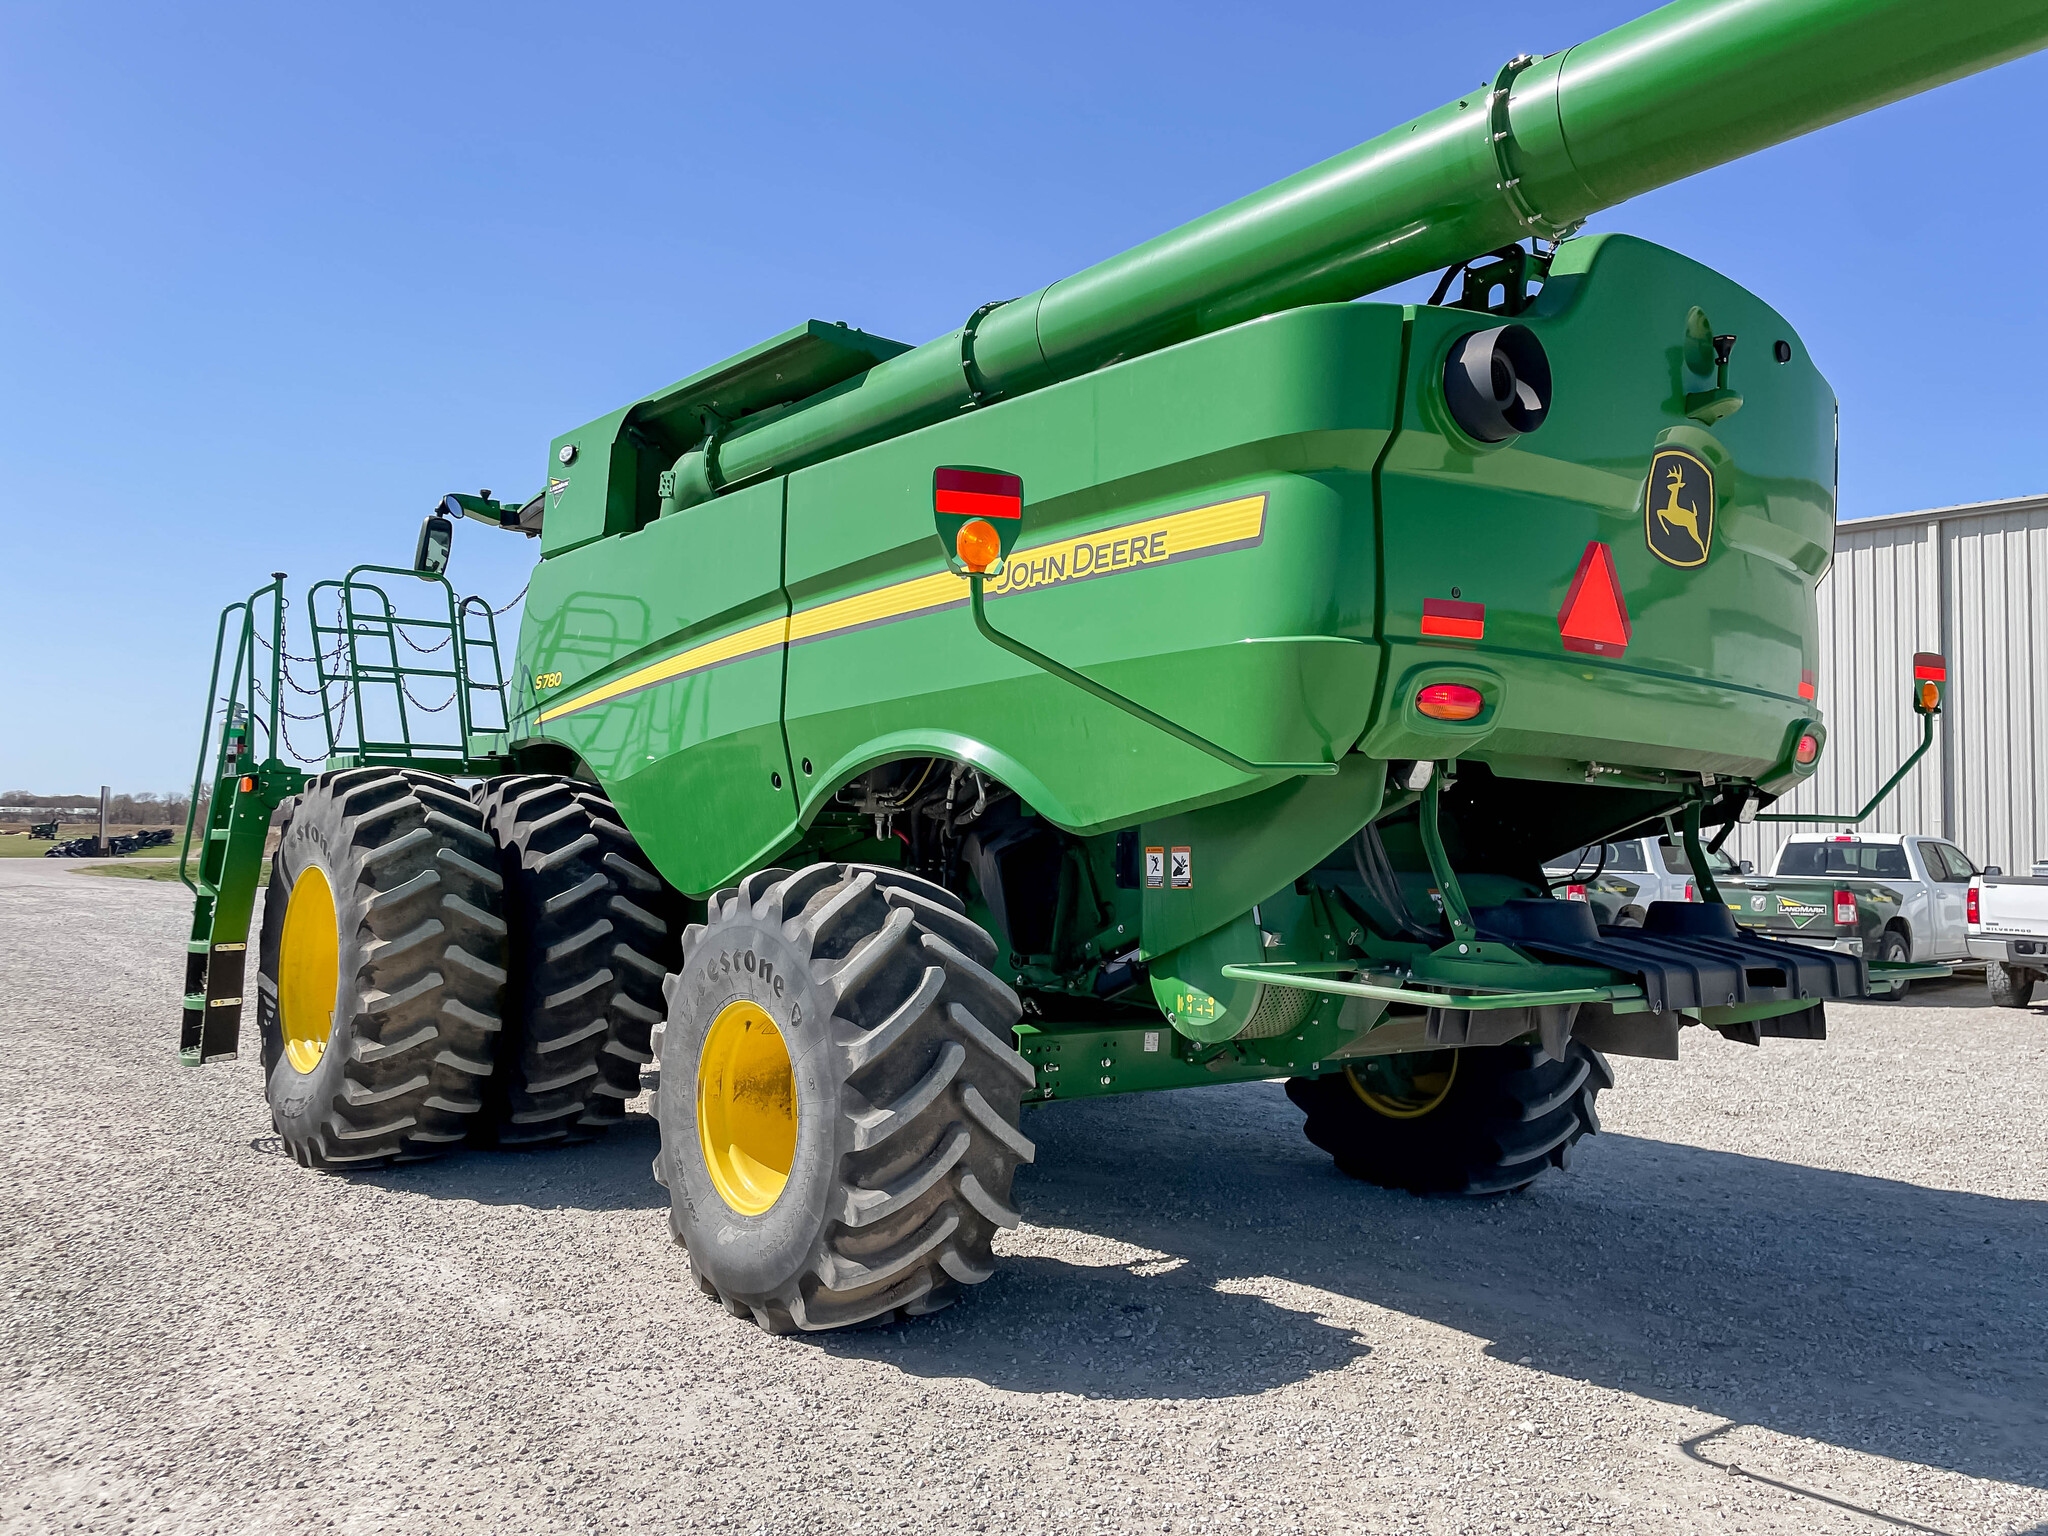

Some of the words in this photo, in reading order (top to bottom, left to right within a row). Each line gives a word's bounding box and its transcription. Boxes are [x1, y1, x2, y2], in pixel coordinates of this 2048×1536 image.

[997, 553, 1066, 590] JOHN
[1072, 530, 1168, 574] DEERE
[535, 671, 562, 690] S780
